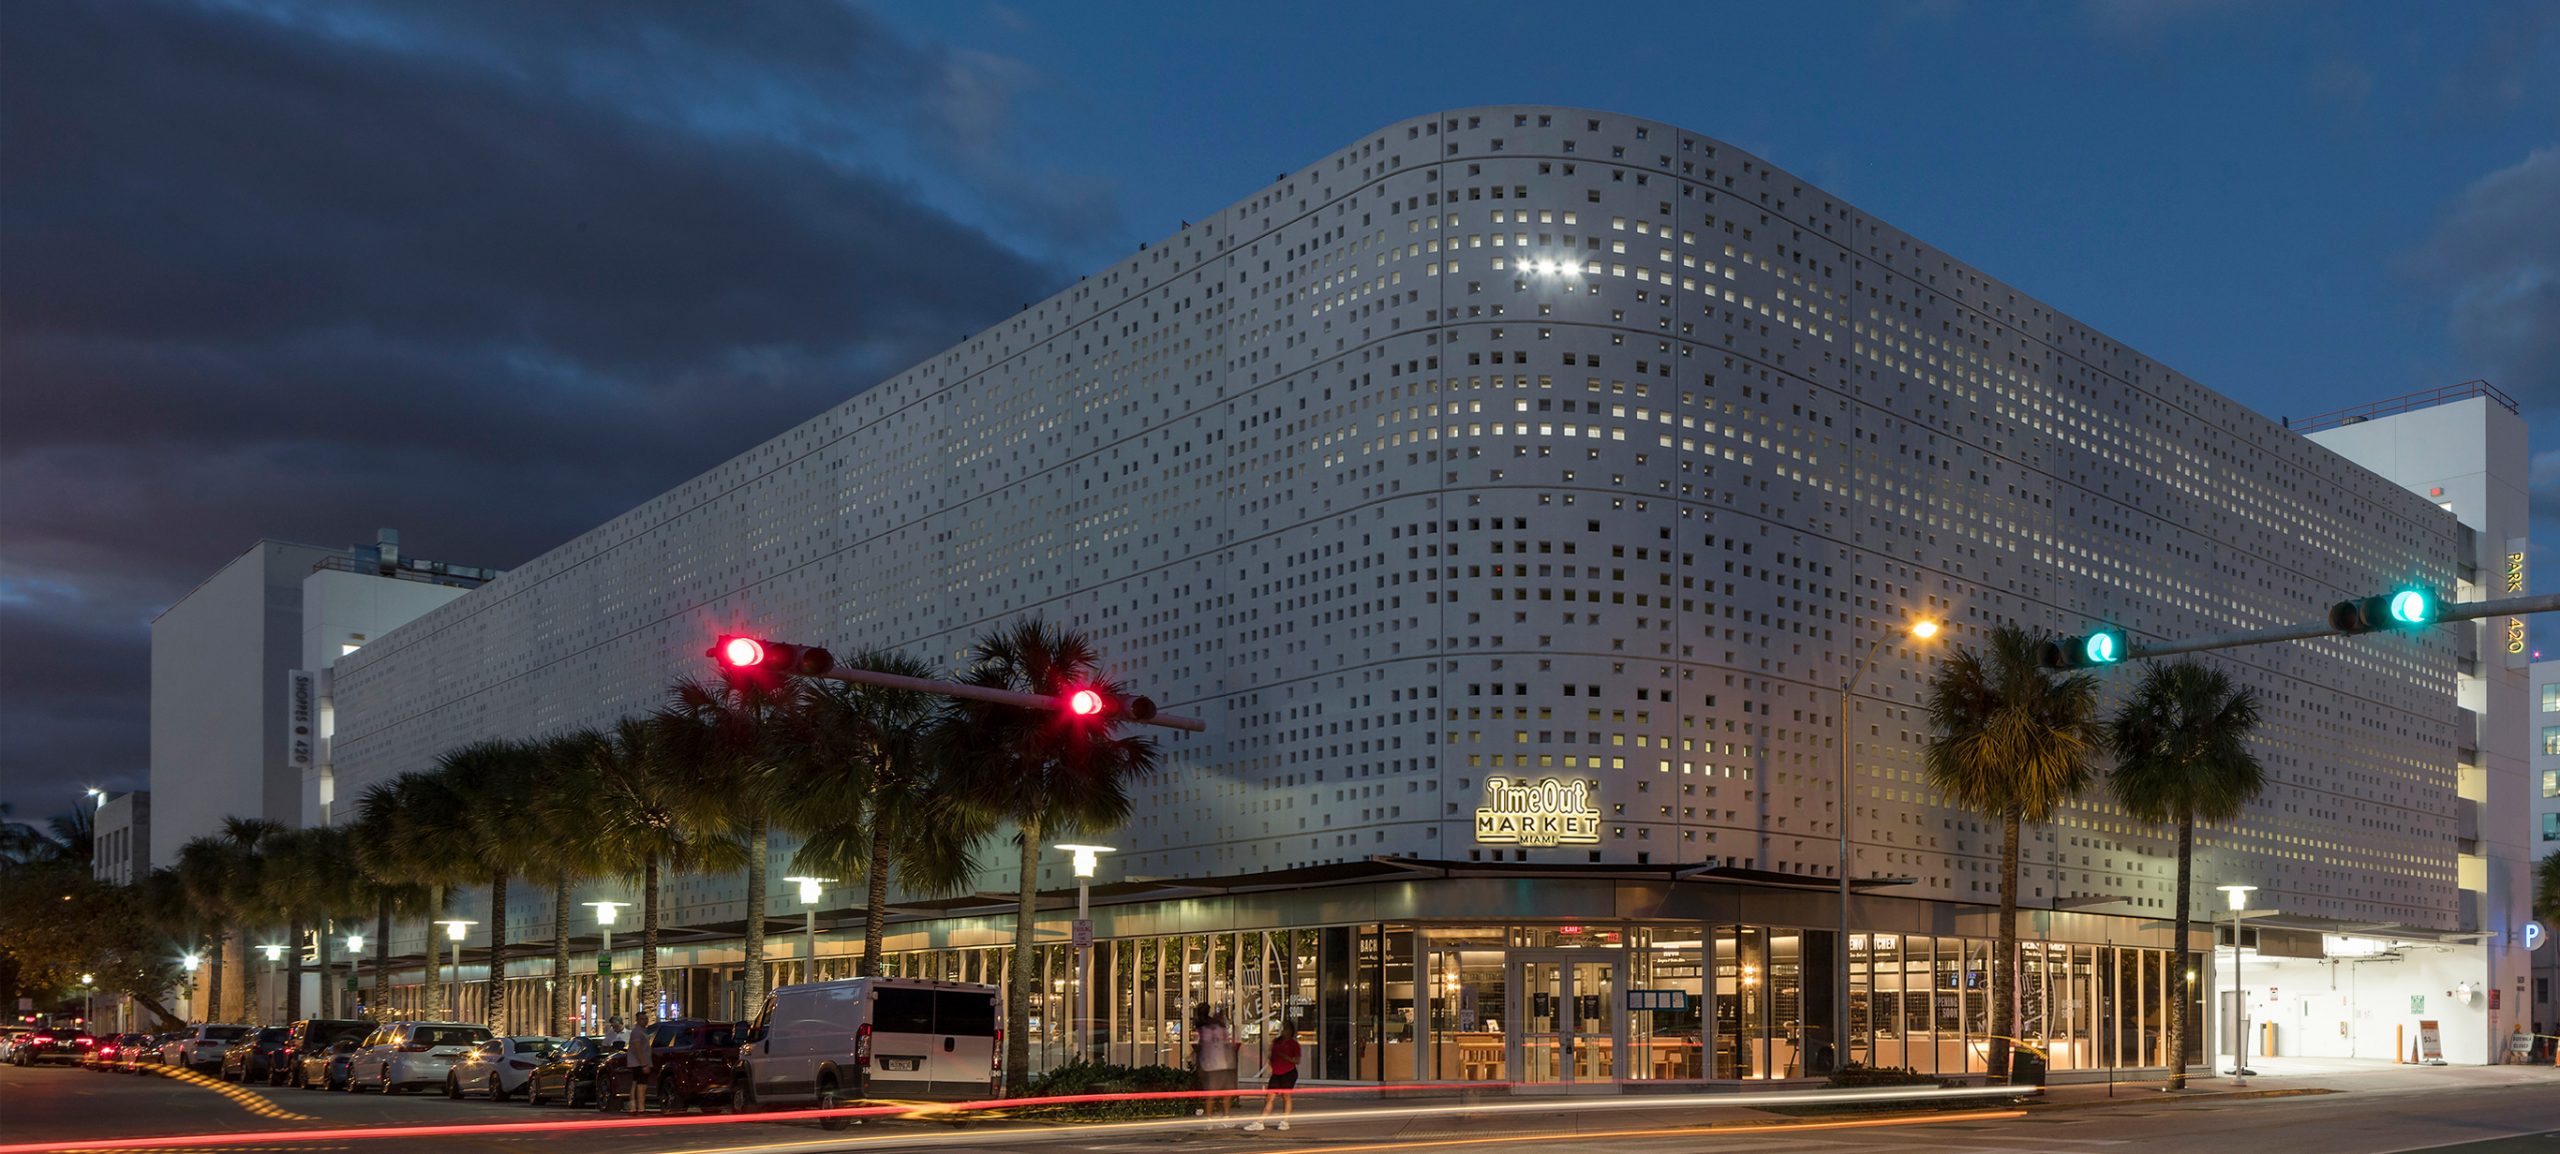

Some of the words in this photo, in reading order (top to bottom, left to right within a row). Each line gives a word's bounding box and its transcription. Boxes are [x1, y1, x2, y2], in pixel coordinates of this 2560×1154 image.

[2508, 551, 2524, 593] PARK
[2508, 616, 2524, 654] 420
[296, 740, 308, 763] 420
[1478, 816, 1598, 833] MARKET
[1519, 835, 1556, 844] MIAMI
[1360, 938, 1392, 953] BACHR
[2524, 924, 2539, 948] P
